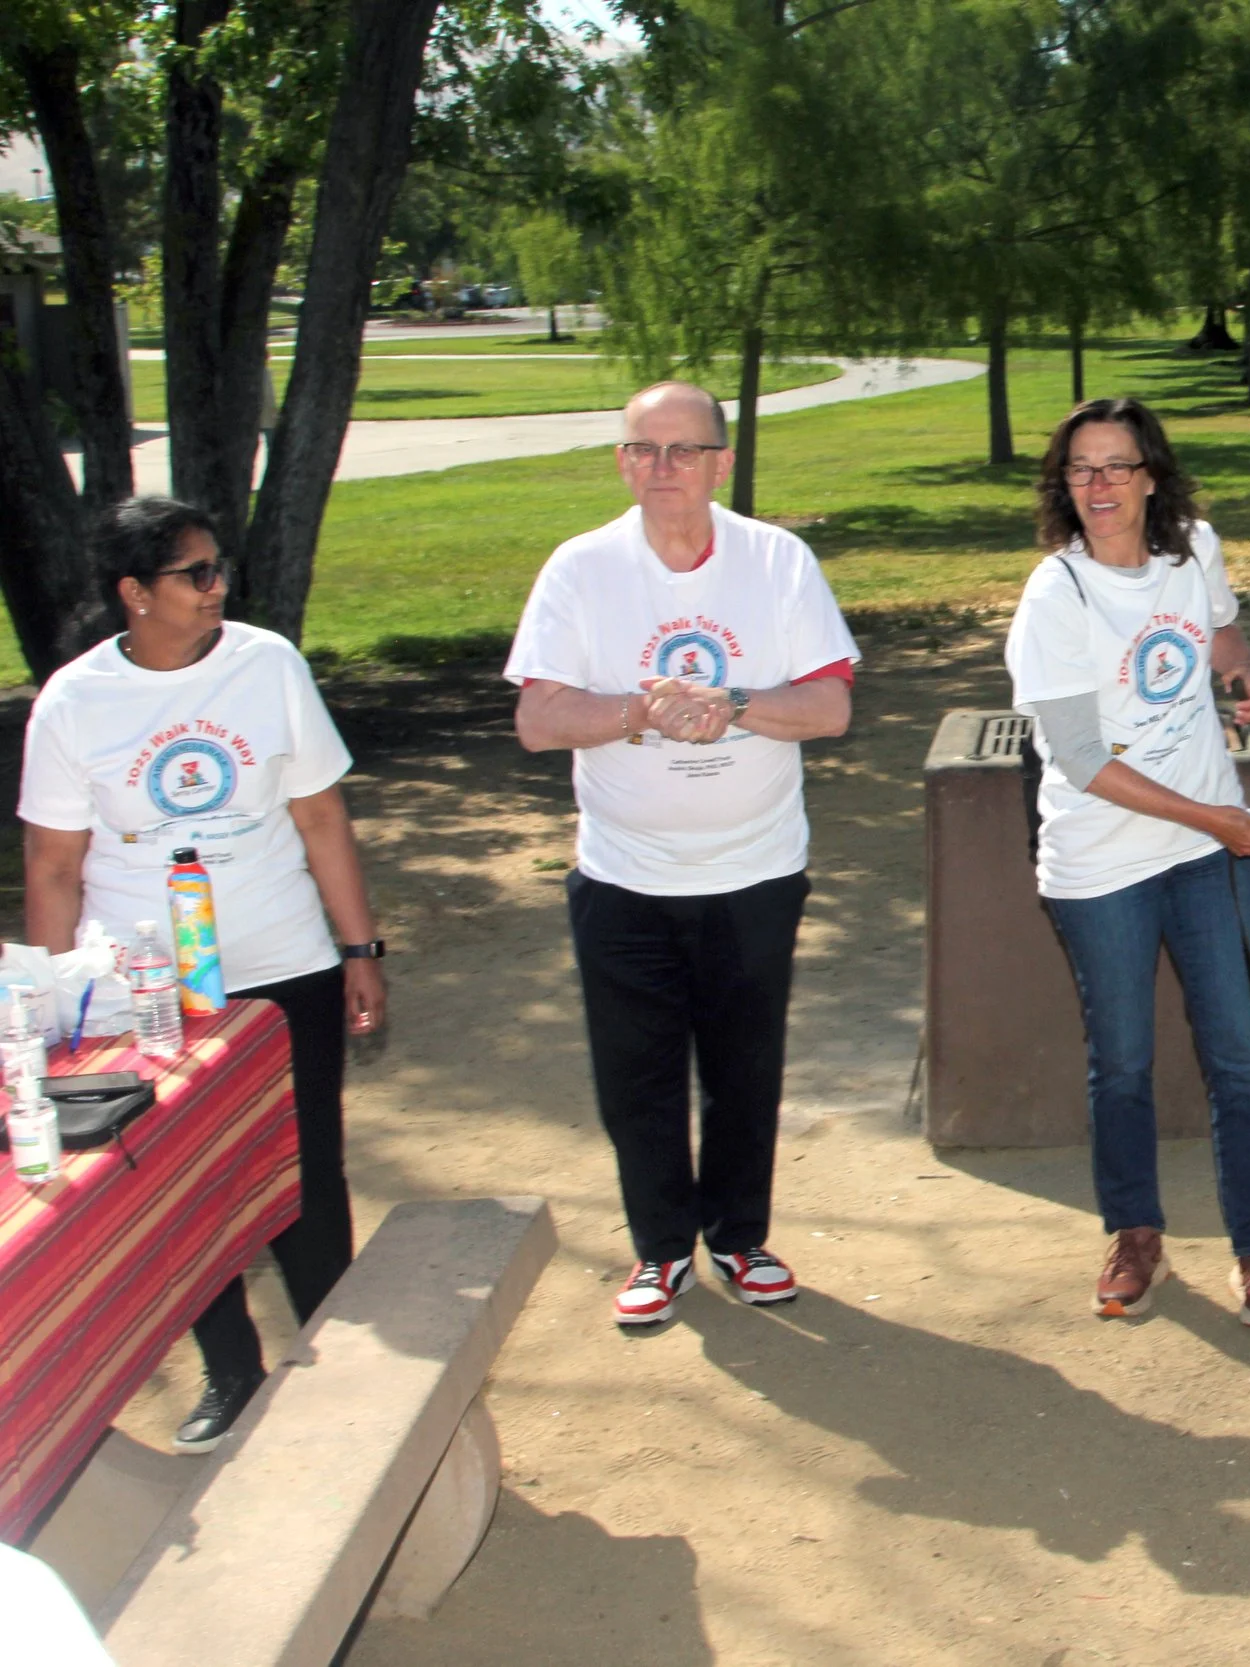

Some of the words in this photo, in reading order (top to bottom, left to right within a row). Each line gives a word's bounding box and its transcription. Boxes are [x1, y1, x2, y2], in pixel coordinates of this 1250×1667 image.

[657, 617, 692, 635] Walk
[721, 627, 744, 657] Way
[1183, 619, 1207, 644] Way
[126, 748, 152, 787] 2025
[149, 723, 189, 748] Walk
[195, 719, 228, 738] This
[231, 734, 256, 767] Way
